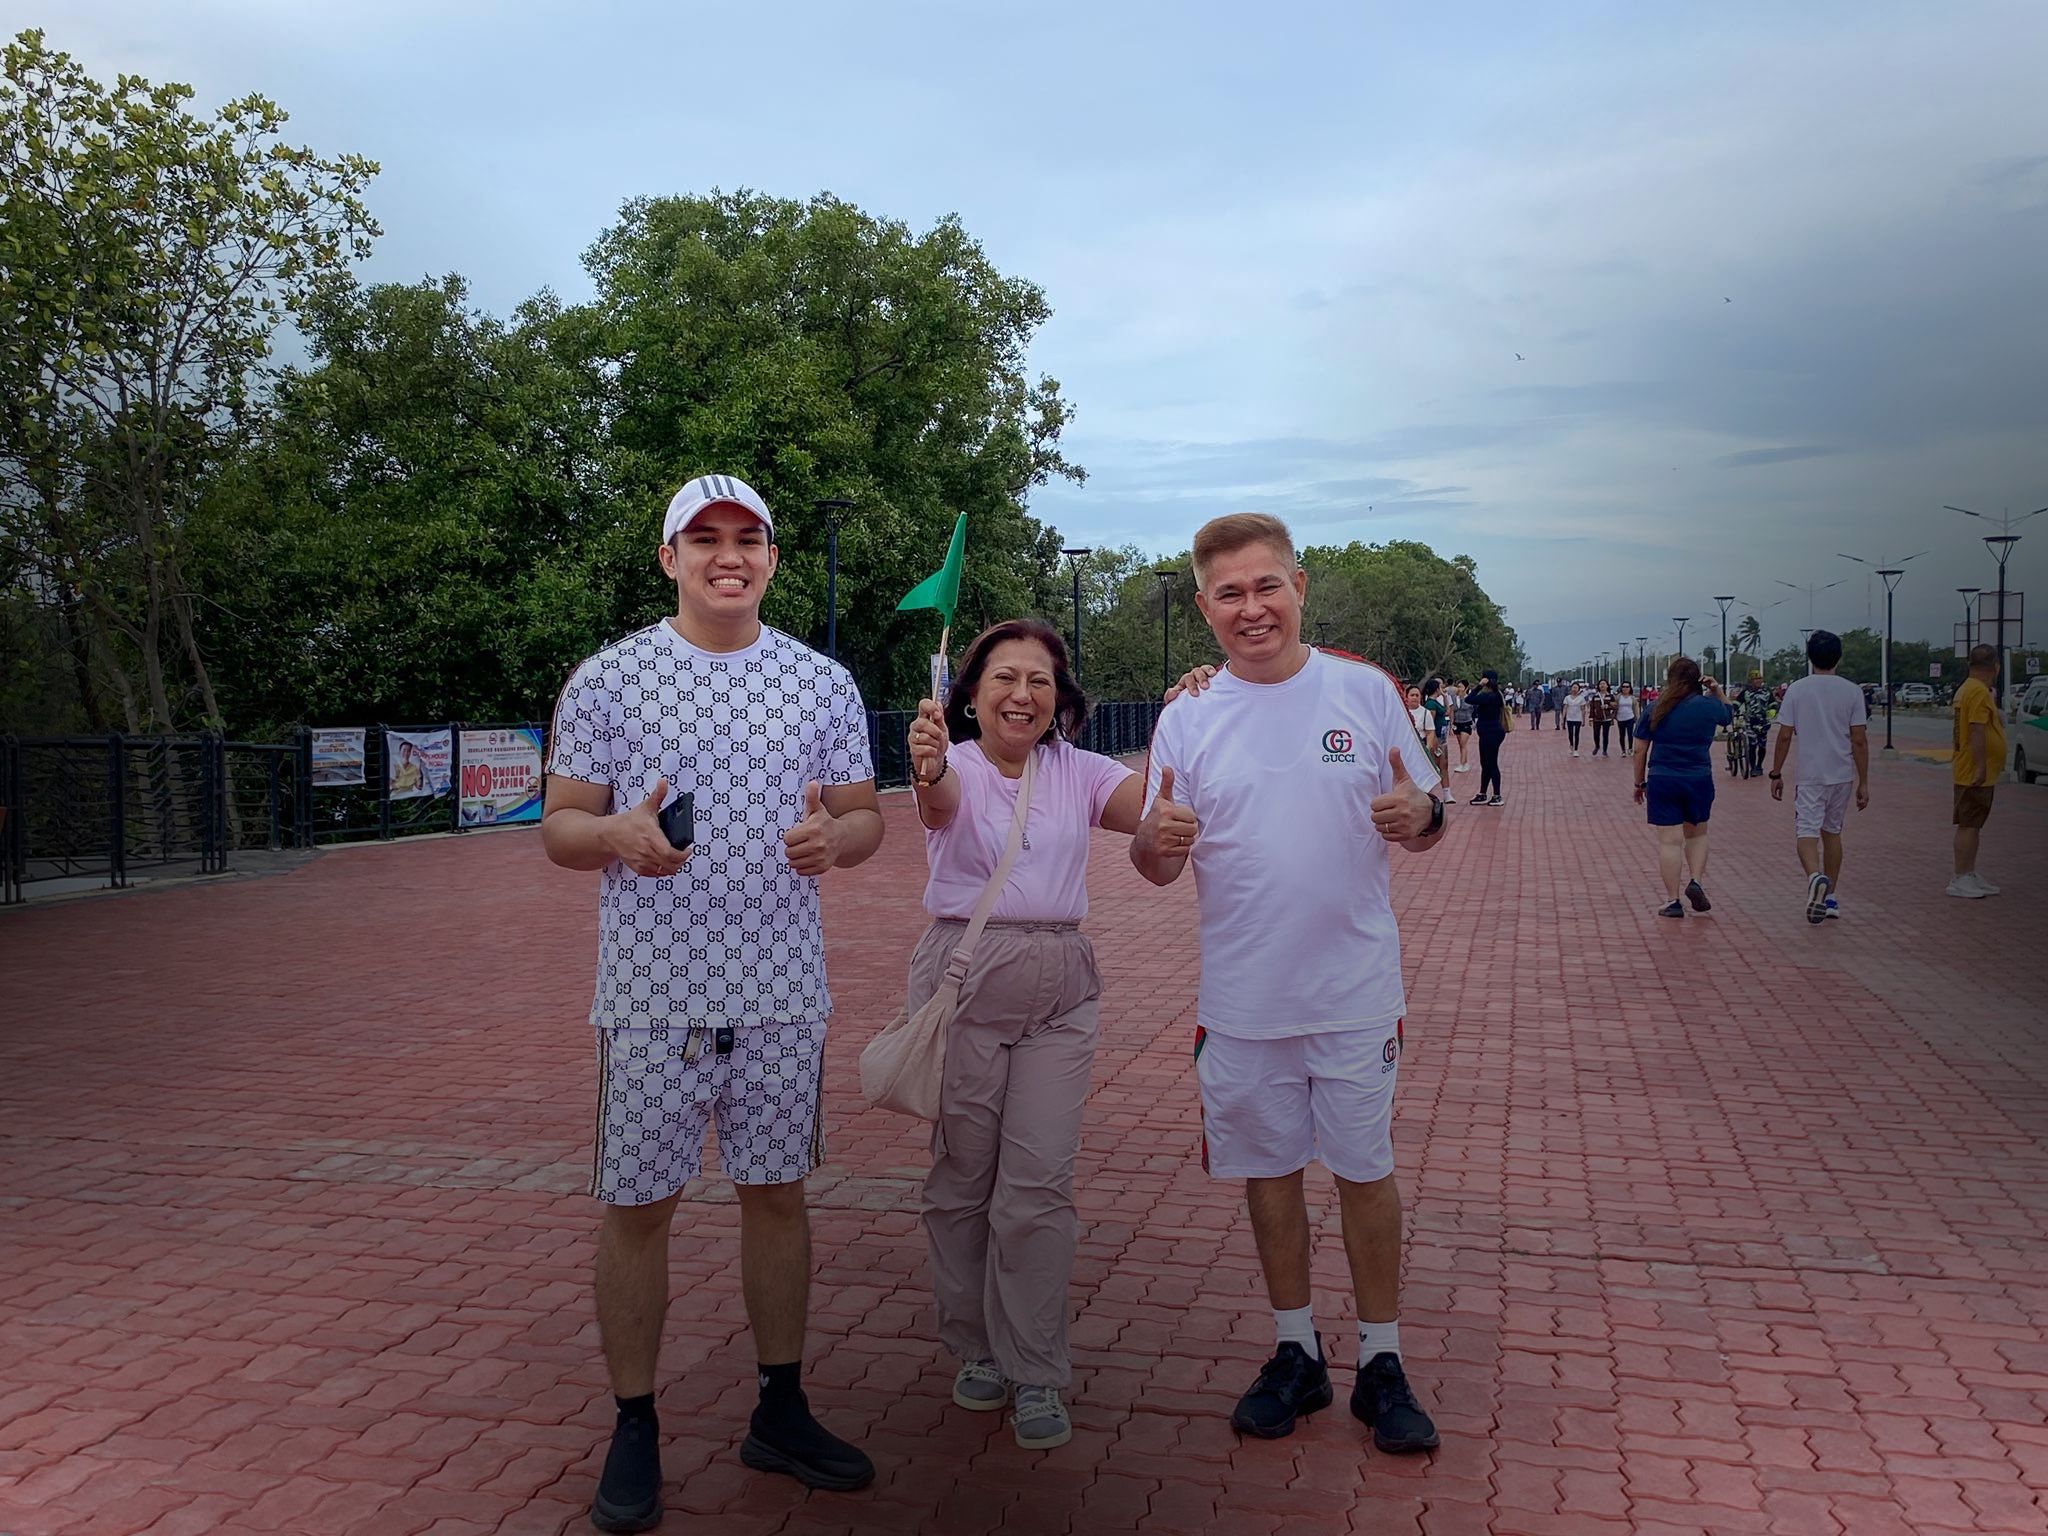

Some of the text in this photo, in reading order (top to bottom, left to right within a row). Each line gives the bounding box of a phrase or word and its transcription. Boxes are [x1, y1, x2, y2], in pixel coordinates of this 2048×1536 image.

[1321, 754, 1355, 762] GUCCI
[461, 764, 531, 798] NO SMOKING
[492, 777, 524, 789] VAPING
